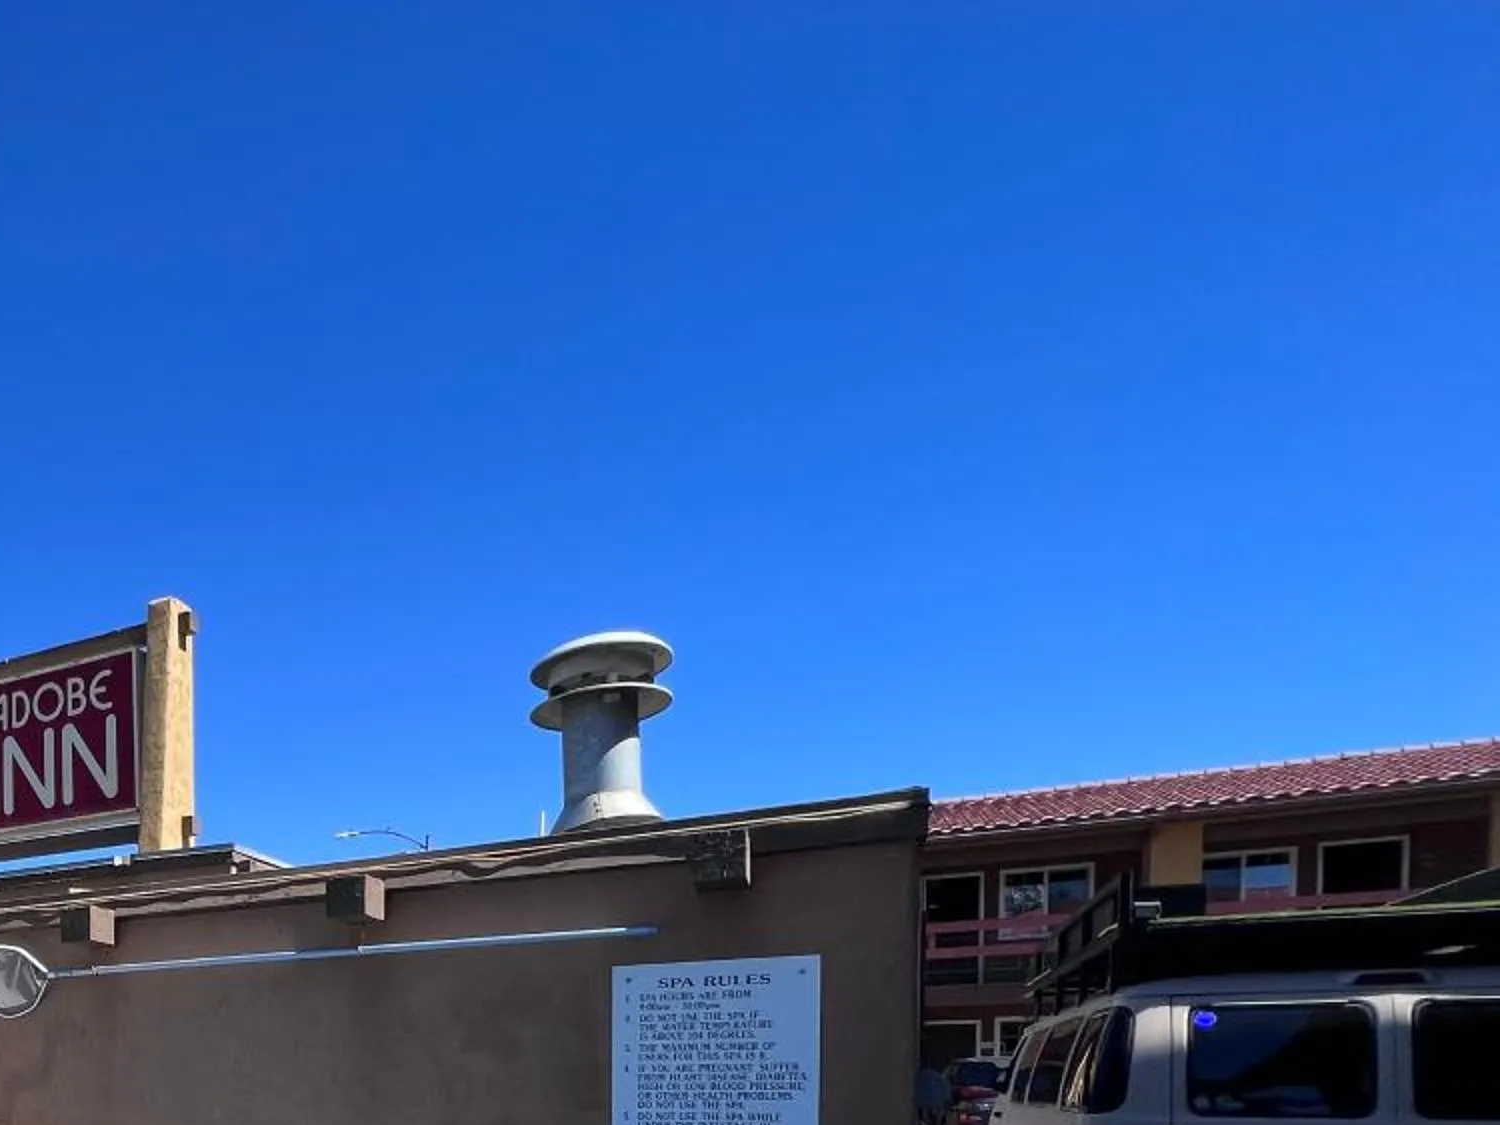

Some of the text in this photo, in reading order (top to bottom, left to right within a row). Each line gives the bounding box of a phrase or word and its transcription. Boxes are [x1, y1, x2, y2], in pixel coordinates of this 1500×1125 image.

[657, 973, 772, 989] SPA RULES
[721, 989, 752, 999] FROM
[657, 1013, 677, 1022] NOT
[709, 1081, 747, 1091] BLOOD
[637, 1101, 653, 1110] DO
[655, 1101, 676, 1110] NOT
[637, 1112, 653, 1121] DO
[655, 1112, 677, 1121] NOT
